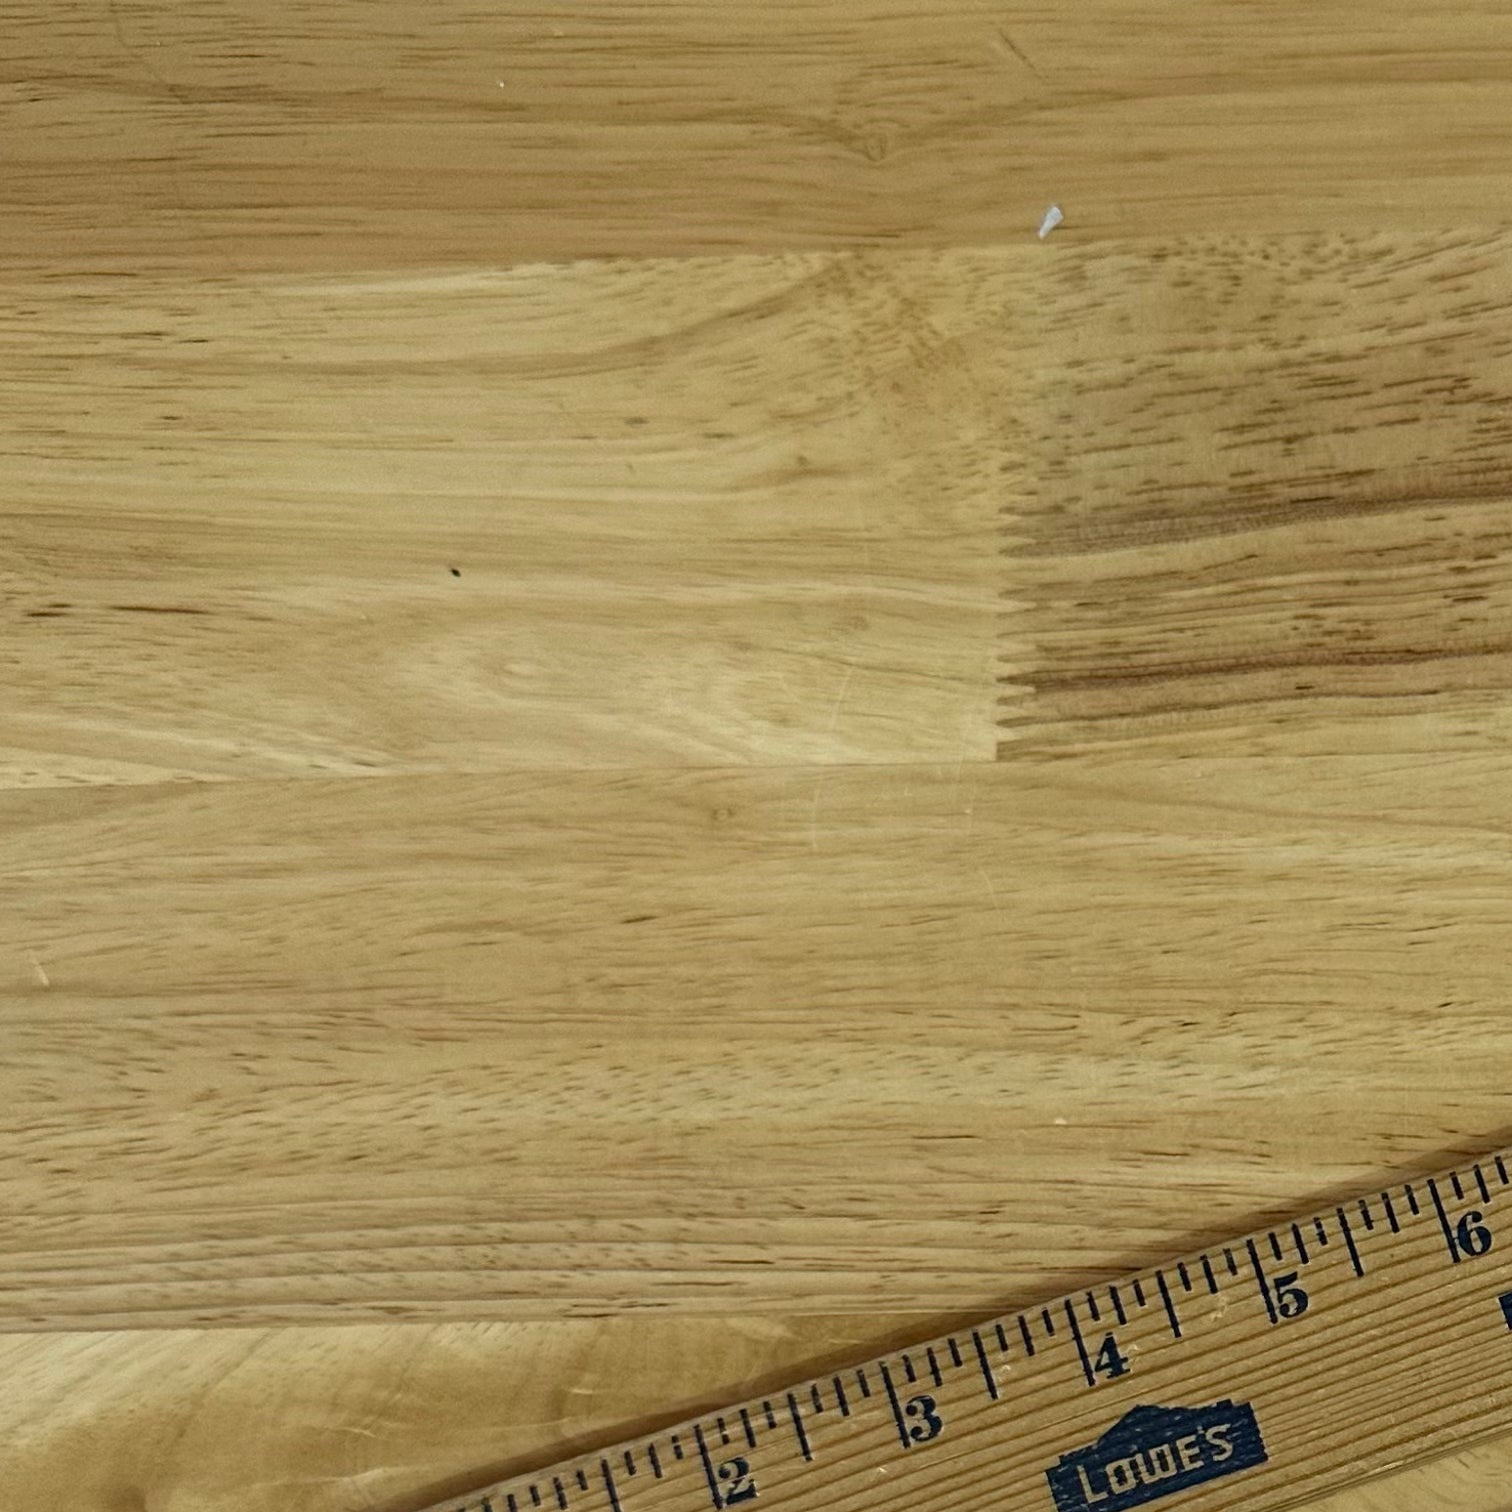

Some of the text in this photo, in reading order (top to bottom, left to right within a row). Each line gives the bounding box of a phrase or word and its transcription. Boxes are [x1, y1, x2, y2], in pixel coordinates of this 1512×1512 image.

[719, 1456, 758, 1505] 2
[909, 1395, 943, 1442] 3
[1094, 1331, 1129, 1379] 4
[1277, 1272, 1309, 1319] 5
[1457, 1211, 1491, 1256] 6
[1077, 1423, 1234, 1504] LOWE'S
